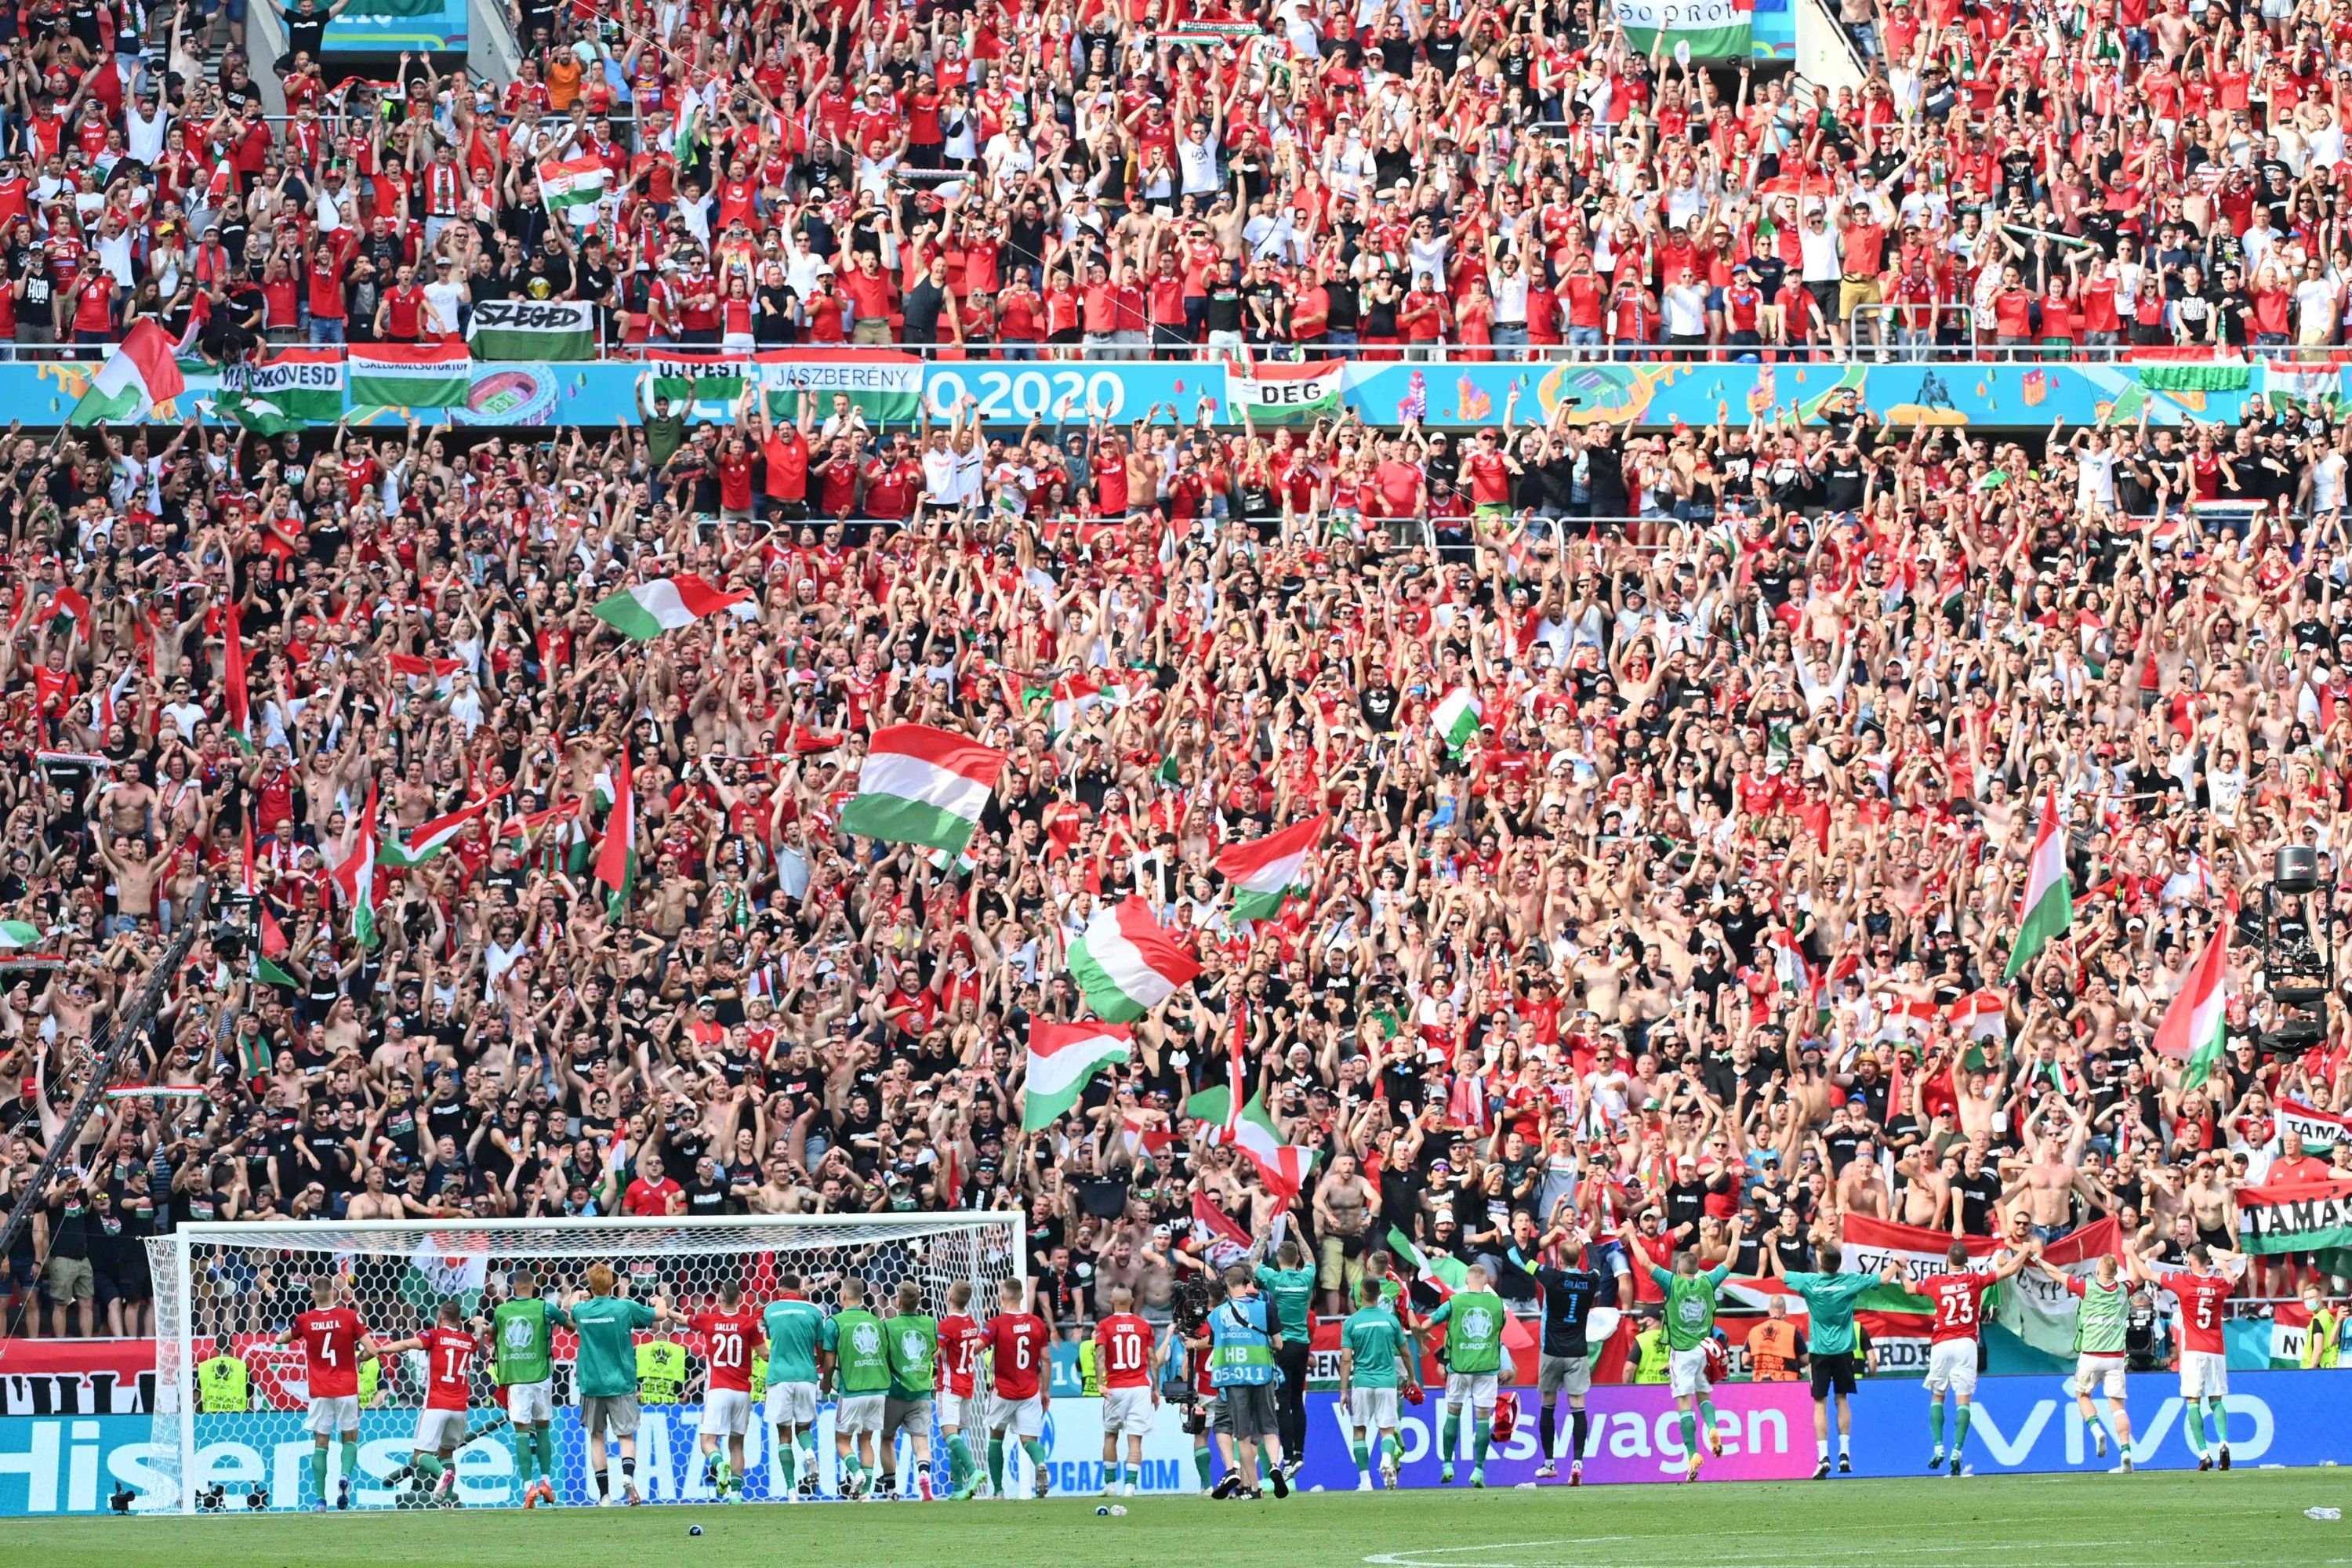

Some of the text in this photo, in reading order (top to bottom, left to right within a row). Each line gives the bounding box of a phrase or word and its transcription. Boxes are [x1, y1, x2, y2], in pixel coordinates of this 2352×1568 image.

[474, 303, 582, 328] SZEGED
[775, 366, 909, 387] JÁSZBERÉNY
[1261, 380, 1322, 405] DÉG
[978, 371, 1125, 419] 2020
[1563, 1293, 1578, 1323] 1
[1941, 1291, 1974, 1326] 23
[2196, 1298, 2213, 1330] 5
[321, 1332, 336, 1367] 4
[712, 1333, 743, 1368] 20
[1016, 1335, 1031, 1370] 6
[1112, 1334, 1142, 1370] 10
[1225, 1347, 1248, 1363] HB
[1214, 1367, 1265, 1383] 05-011
[1969, 1375, 2274, 1467] vivo
[0, 1420, 514, 1512] Hisense
